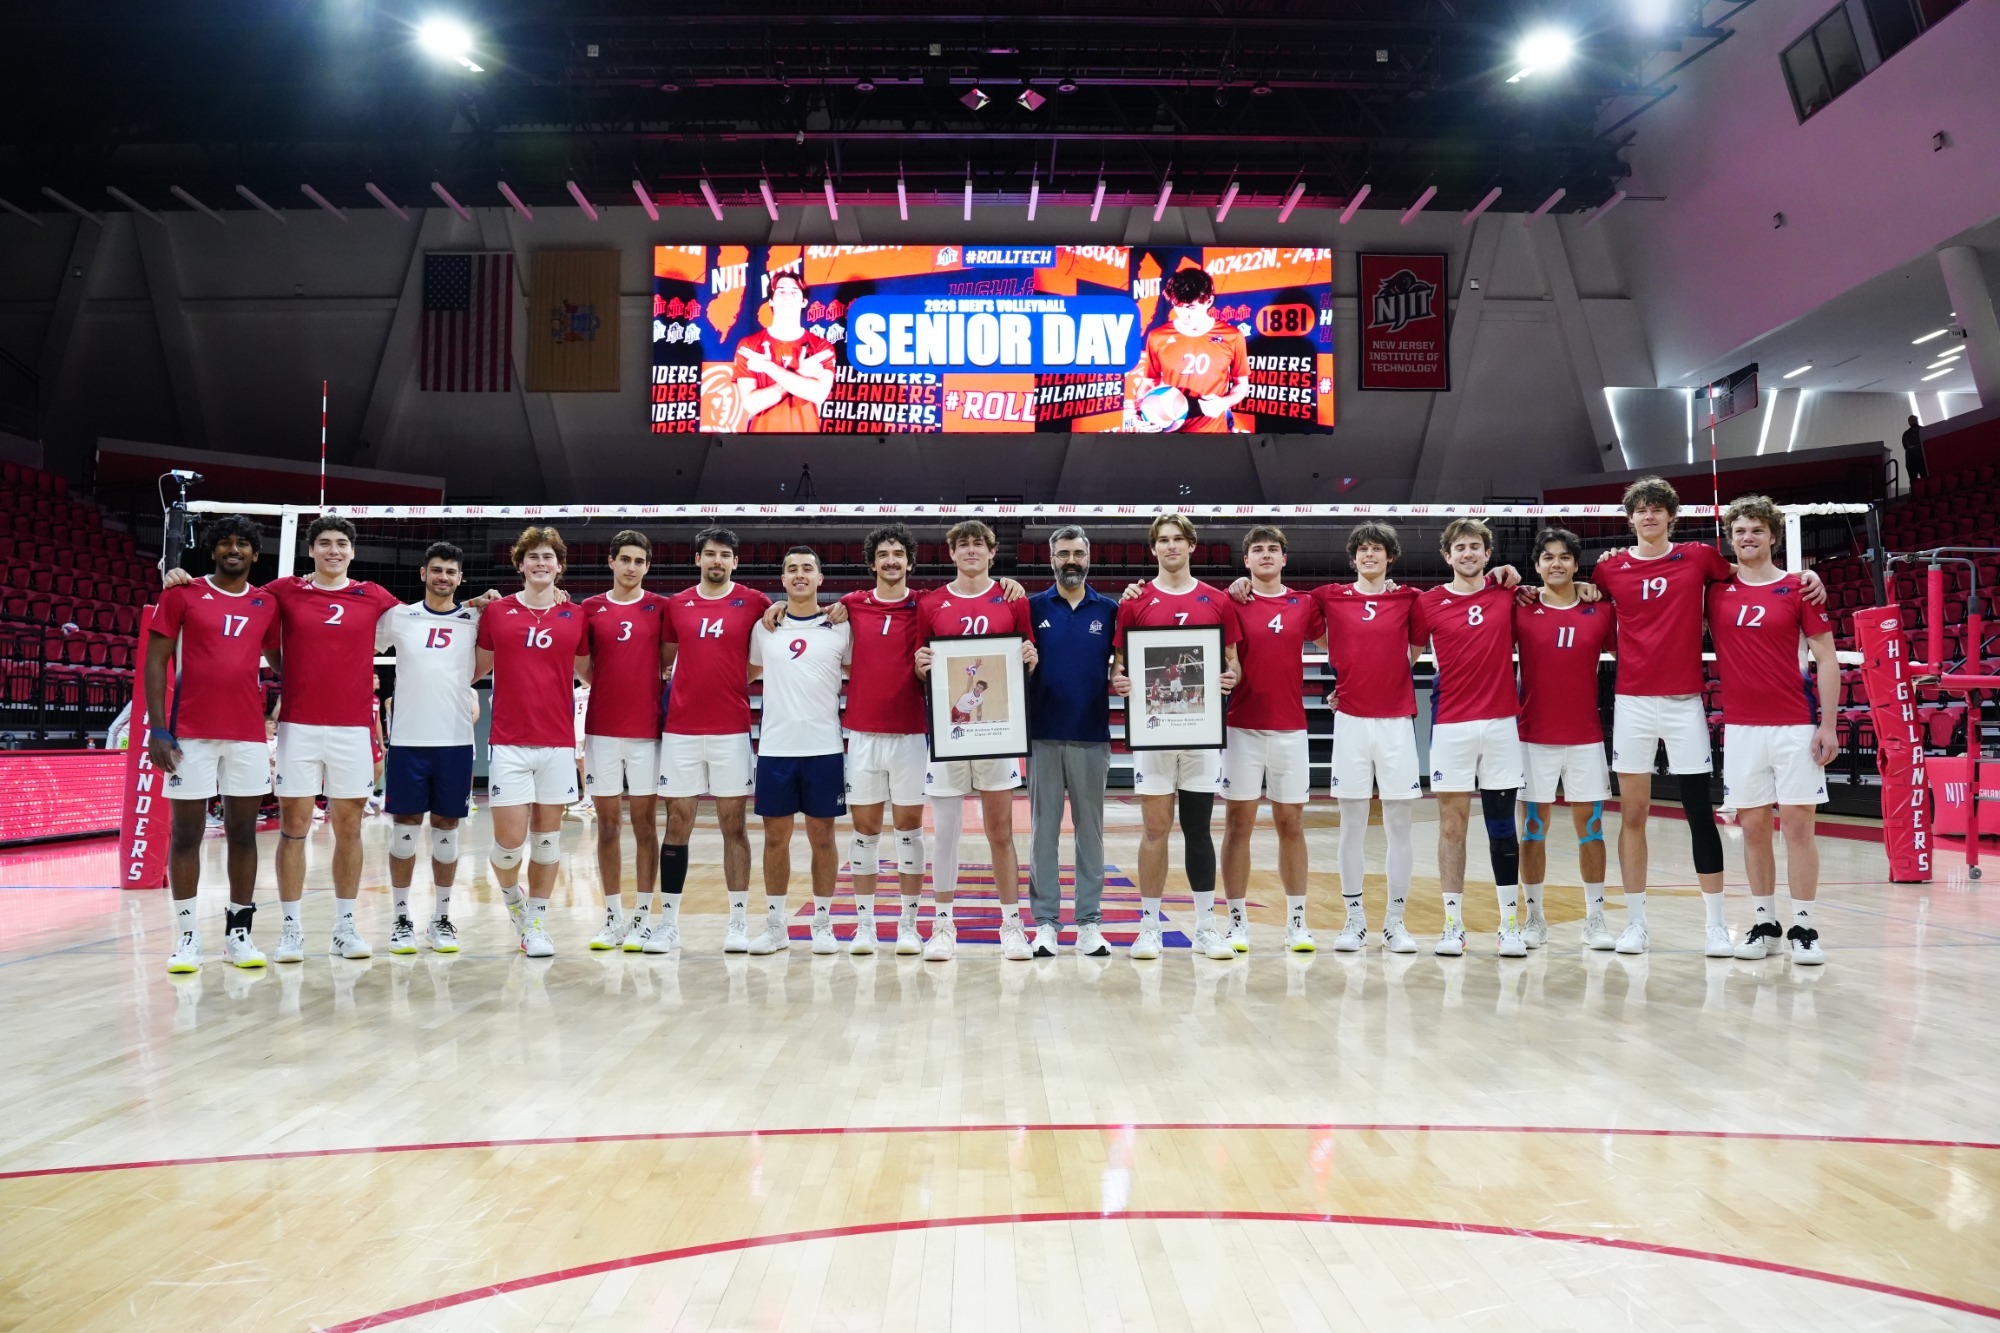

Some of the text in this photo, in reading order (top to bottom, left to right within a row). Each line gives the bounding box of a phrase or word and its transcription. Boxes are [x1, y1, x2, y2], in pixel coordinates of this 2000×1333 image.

[966, 250, 1051, 264] #ROLLTECH
[711, 263, 749, 294] NJIT
[1133, 278, 1162, 299] NJIT
[958, 299, 994, 312] MEN'S
[996, 299, 1066, 312] VOLLEYBALL
[1376, 289, 1433, 327] NJIT
[1262, 308, 1307, 332] 1881
[855, 313, 1134, 366] SENIOR DAY
[1372, 340, 1435, 350] NEW JERSEY
[782, 356, 793, 369] 7
[1181, 353, 1211, 375] 20
[1369, 351, 1439, 361] INSTITUTE OF
[652, 366, 698, 384] DERS
[1371, 363, 1438, 373] TECHNOLOGY
[652, 402, 697, 422] DERS
[945, 391, 1036, 422] #ROLL
[1642, 577, 1667, 600] 19
[324, 604, 344, 625] 2
[1174, 612, 1189, 625] 7
[1362, 601, 1378, 621] 5
[1467, 605, 1484, 626] 8
[1736, 605, 1765, 627] 12
[223, 614, 249, 637] 17
[616, 621, 632, 642] 3
[699, 618, 724, 638] 14
[881, 615, 892, 636] 1
[961, 615, 989, 635] 20
[1268, 613, 1284, 634] 4
[426, 628, 452, 649] 15
[526, 626, 552, 648] 16
[1556, 626, 1576, 648] 11
[789, 638, 807, 660] 9
[1887, 639, 1929, 872] HIGHLANDERS
[1944, 782, 1967, 808] NJI
